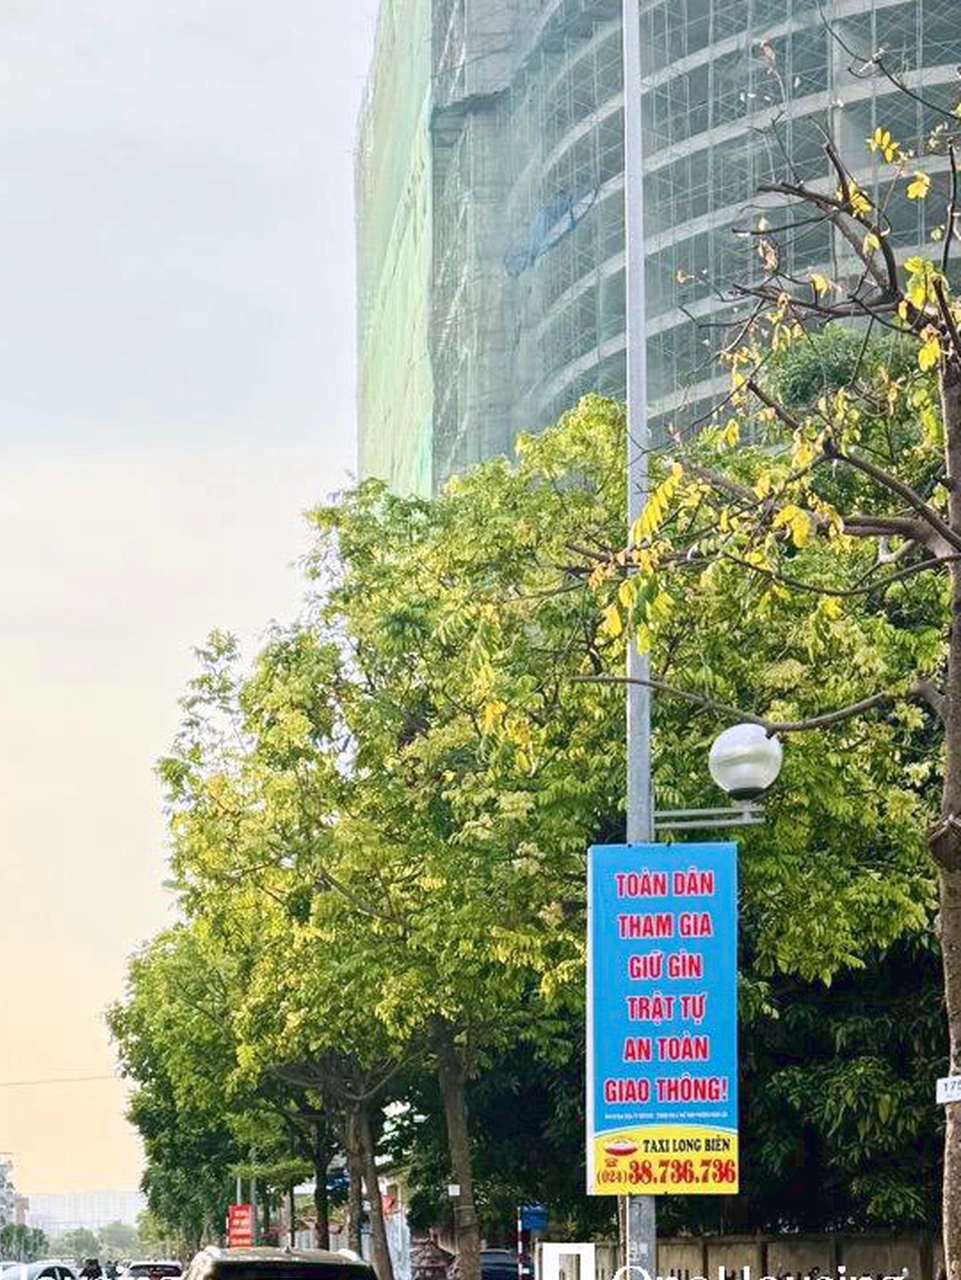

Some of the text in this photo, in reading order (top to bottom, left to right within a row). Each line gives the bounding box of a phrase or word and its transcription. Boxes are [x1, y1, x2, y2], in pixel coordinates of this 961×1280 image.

[615, 867, 714, 897] TOÀN DÂN
[619, 912, 712, 938] THAM GIA
[629, 949, 703, 979] GIỮ GÌN
[628, 990, 707, 1025] TRẬT TỰ
[623, 1031, 709, 1062] AN TOÀN
[605, 1073, 728, 1103] GIAO THÔNG!
[643, 1139, 670, 1153] TAXI
[672, 1138, 701, 1152] LONG
